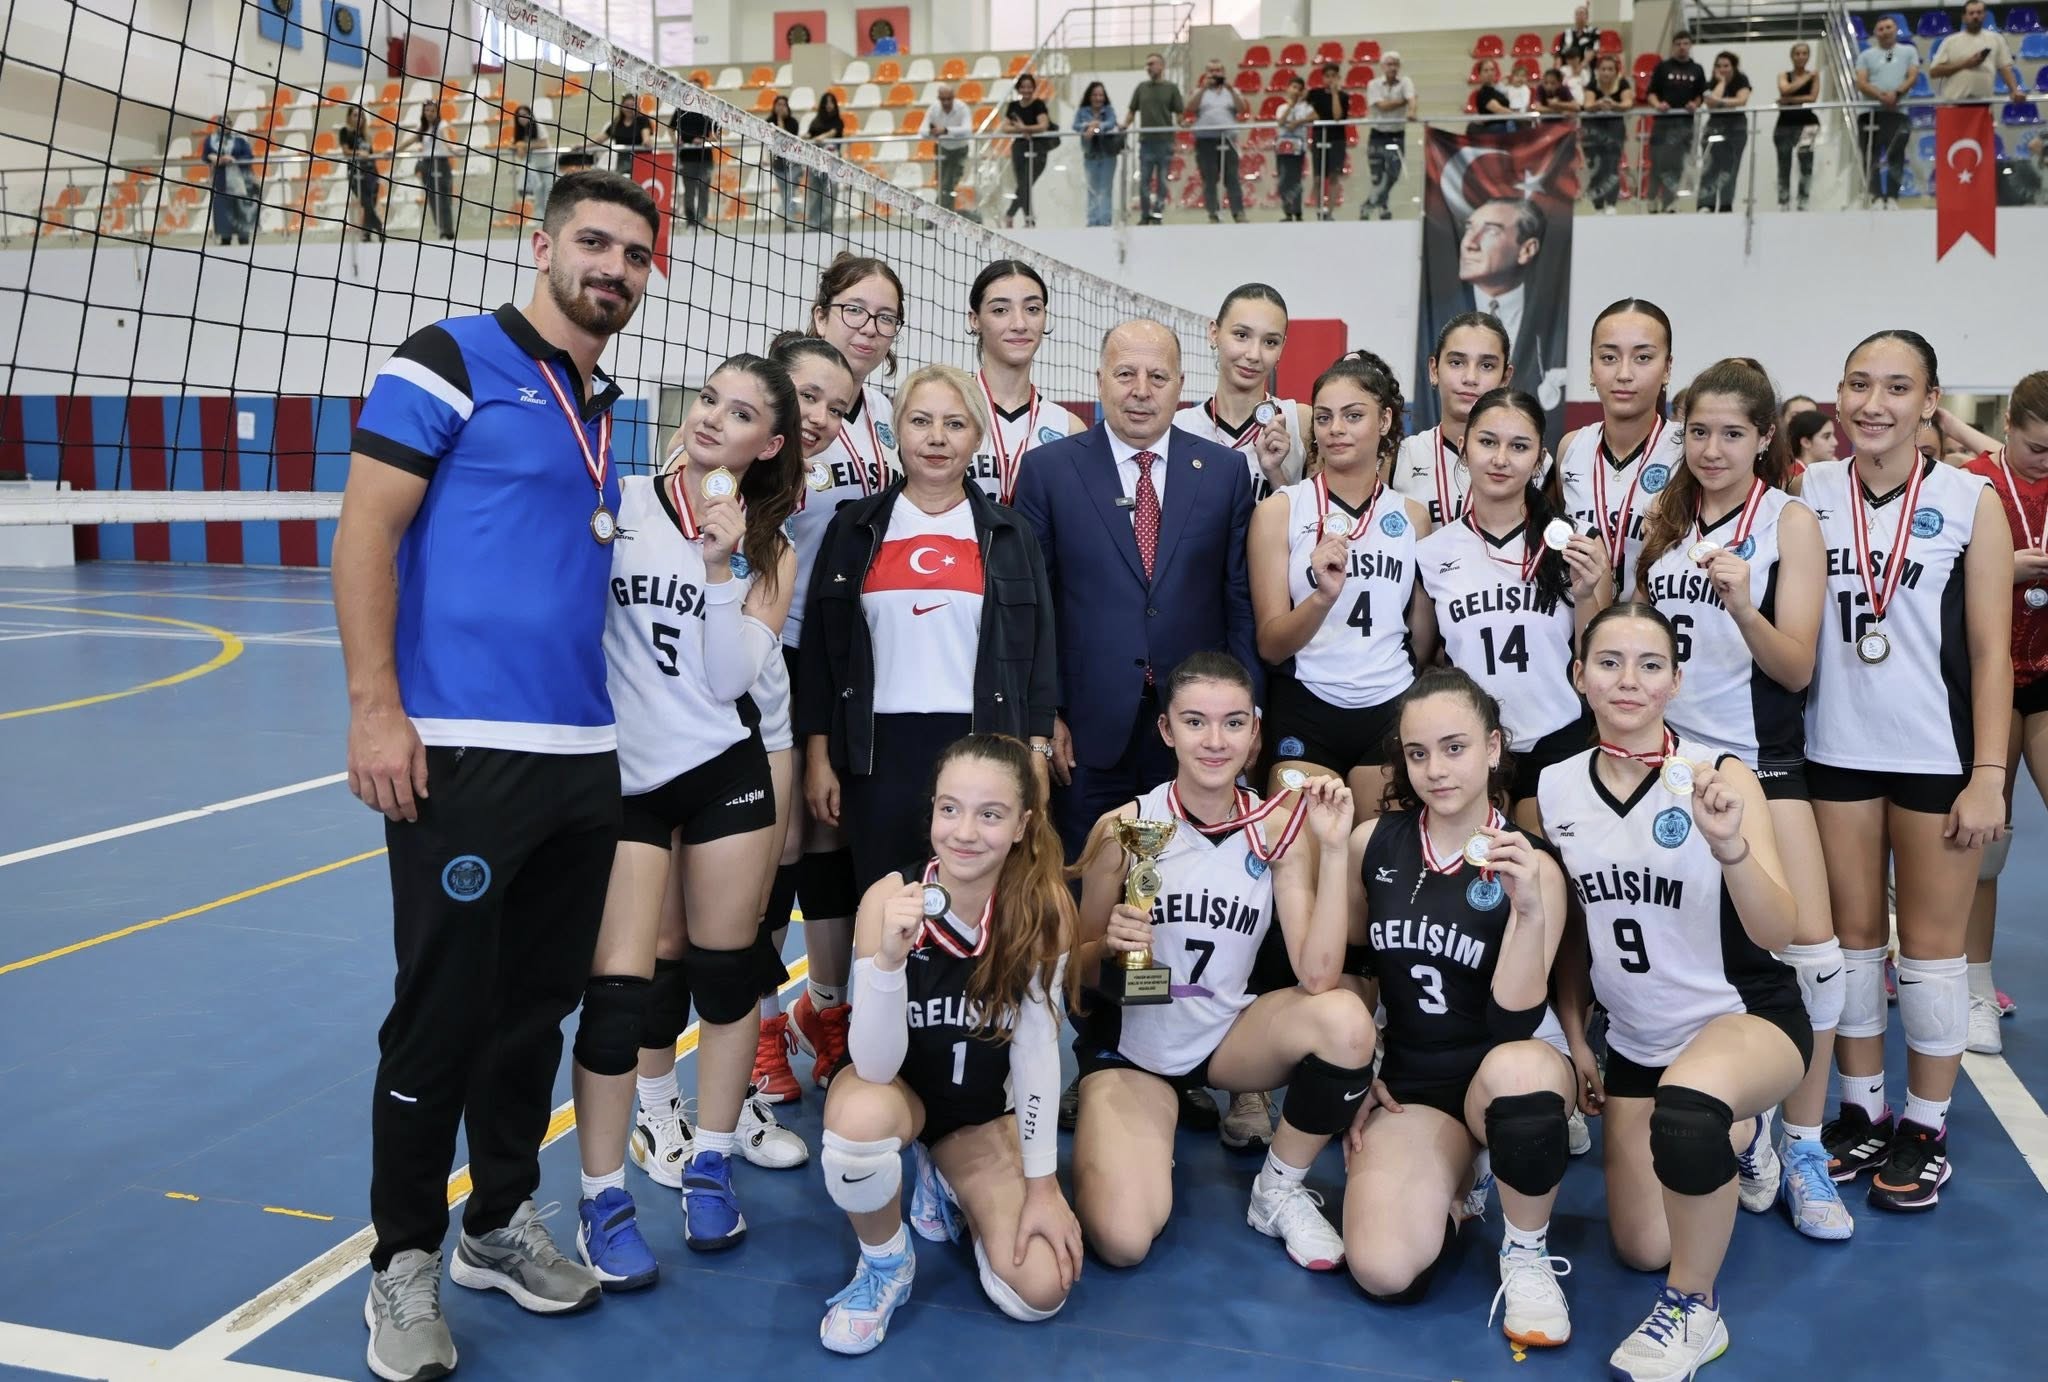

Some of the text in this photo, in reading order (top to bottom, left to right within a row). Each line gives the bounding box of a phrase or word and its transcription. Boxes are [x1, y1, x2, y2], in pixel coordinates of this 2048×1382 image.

[571, 35, 586, 49] TVF
[613, 55, 625, 69] VF
[611, 574, 706, 620] GELİŞİ
[1346, 591, 1373, 637] 4
[1837, 590, 1887, 643] 12
[652, 622, 681, 677] 5
[1480, 624, 1529, 676] 14
[1670, 614, 1694, 662] 6
[1571, 863, 1684, 910] GELİŞİM
[1149, 888, 1260, 936] GELİŞİM
[1185, 938, 1216, 985] 7
[1370, 915, 1486, 970] GELİŞİM
[1612, 918, 1651, 974] 9
[1410, 964, 1449, 1015] 3
[952, 1041, 967, 1085] 1
[1024, 1094, 1041, 1141] KIPSTA
